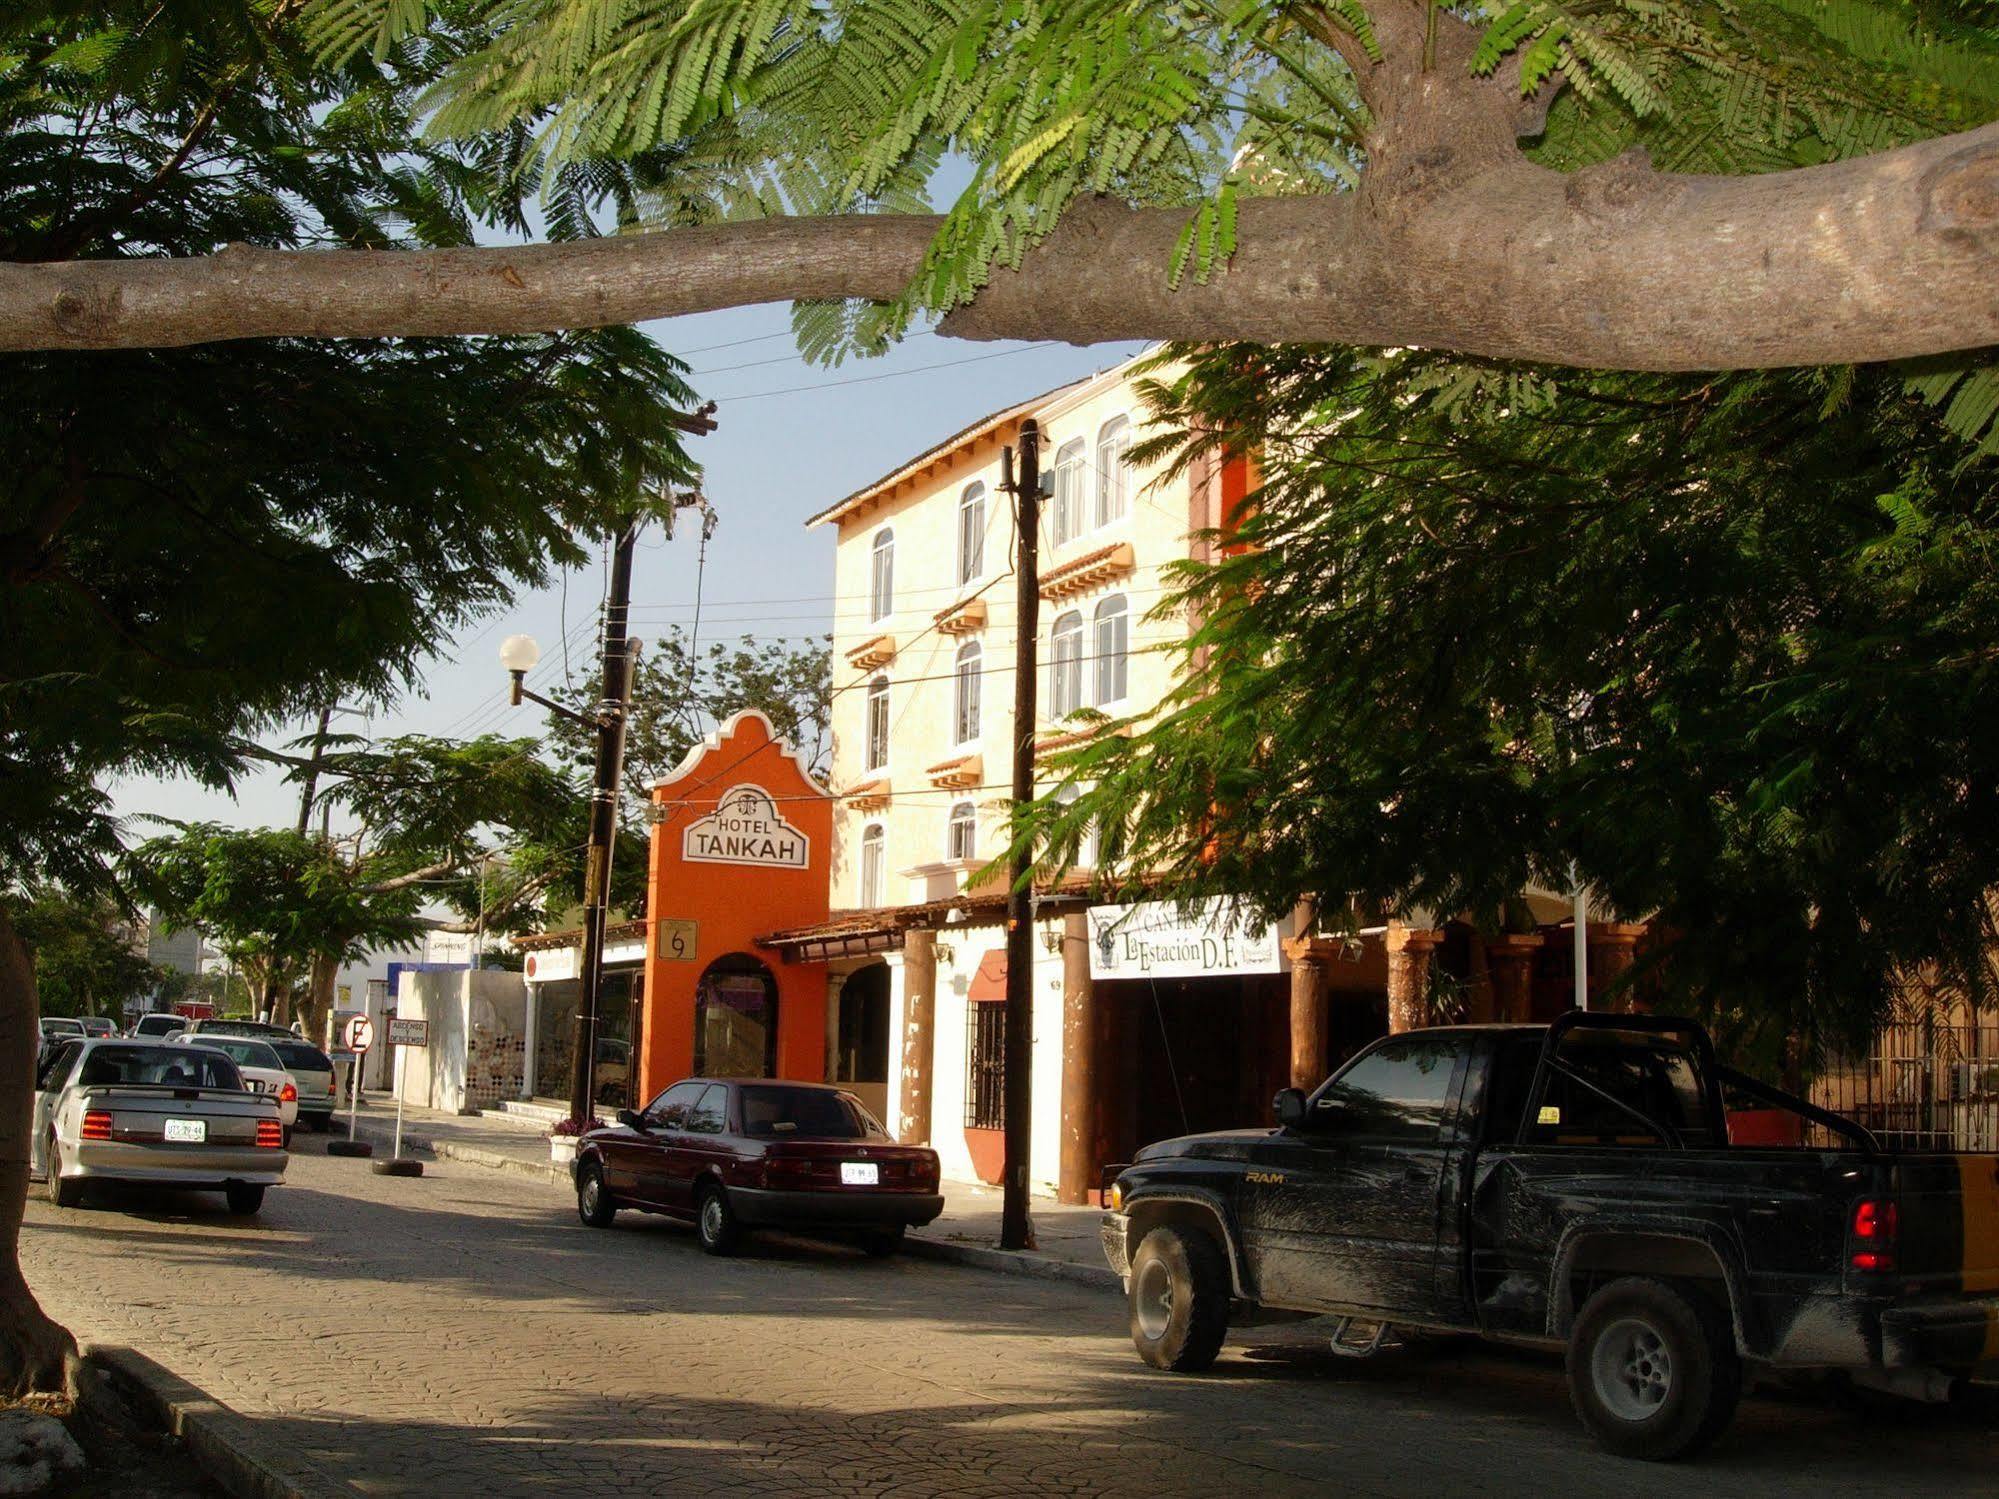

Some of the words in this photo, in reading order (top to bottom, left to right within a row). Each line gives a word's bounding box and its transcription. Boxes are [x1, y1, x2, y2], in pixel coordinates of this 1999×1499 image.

[720, 819, 771, 834] HOTEL
[697, 835, 794, 860] TANKAH
[1122, 931, 1138, 961] La
[1138, 937, 1201, 971] Estación
[1200, 935, 1239, 969] D.F.
[1244, 1172, 1283, 1184] RAM
